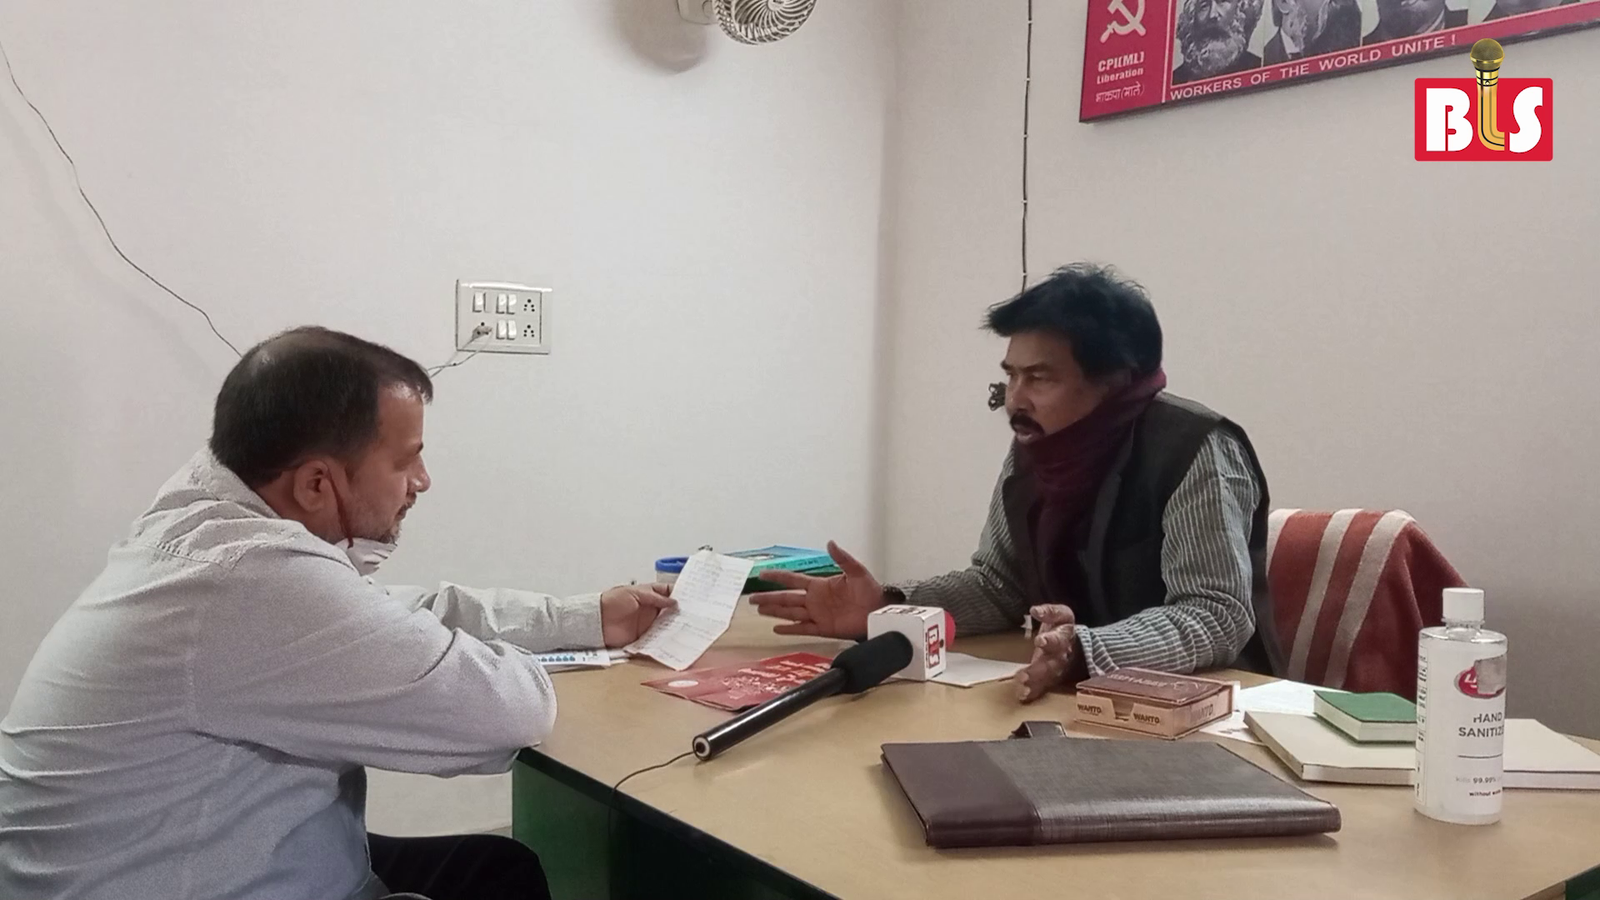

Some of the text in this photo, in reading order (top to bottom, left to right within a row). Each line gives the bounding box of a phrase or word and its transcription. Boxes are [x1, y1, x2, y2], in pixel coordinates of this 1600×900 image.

[1170, 77, 1242, 100] WORKERS
[1250, 71, 1270, 85] OF
[1280, 63, 1310, 78] THE
[1319, 49, 1382, 71] WORLD
[1391, 36, 1445, 57] UNITE
[1096, 67, 1144, 85] Liberation
[1077, 703, 1102, 714] WANTO
[1133, 713, 1160, 724] WANTO
[1473, 712, 1502, 723] HAND
[1458, 726, 1504, 738] SANITIZ
